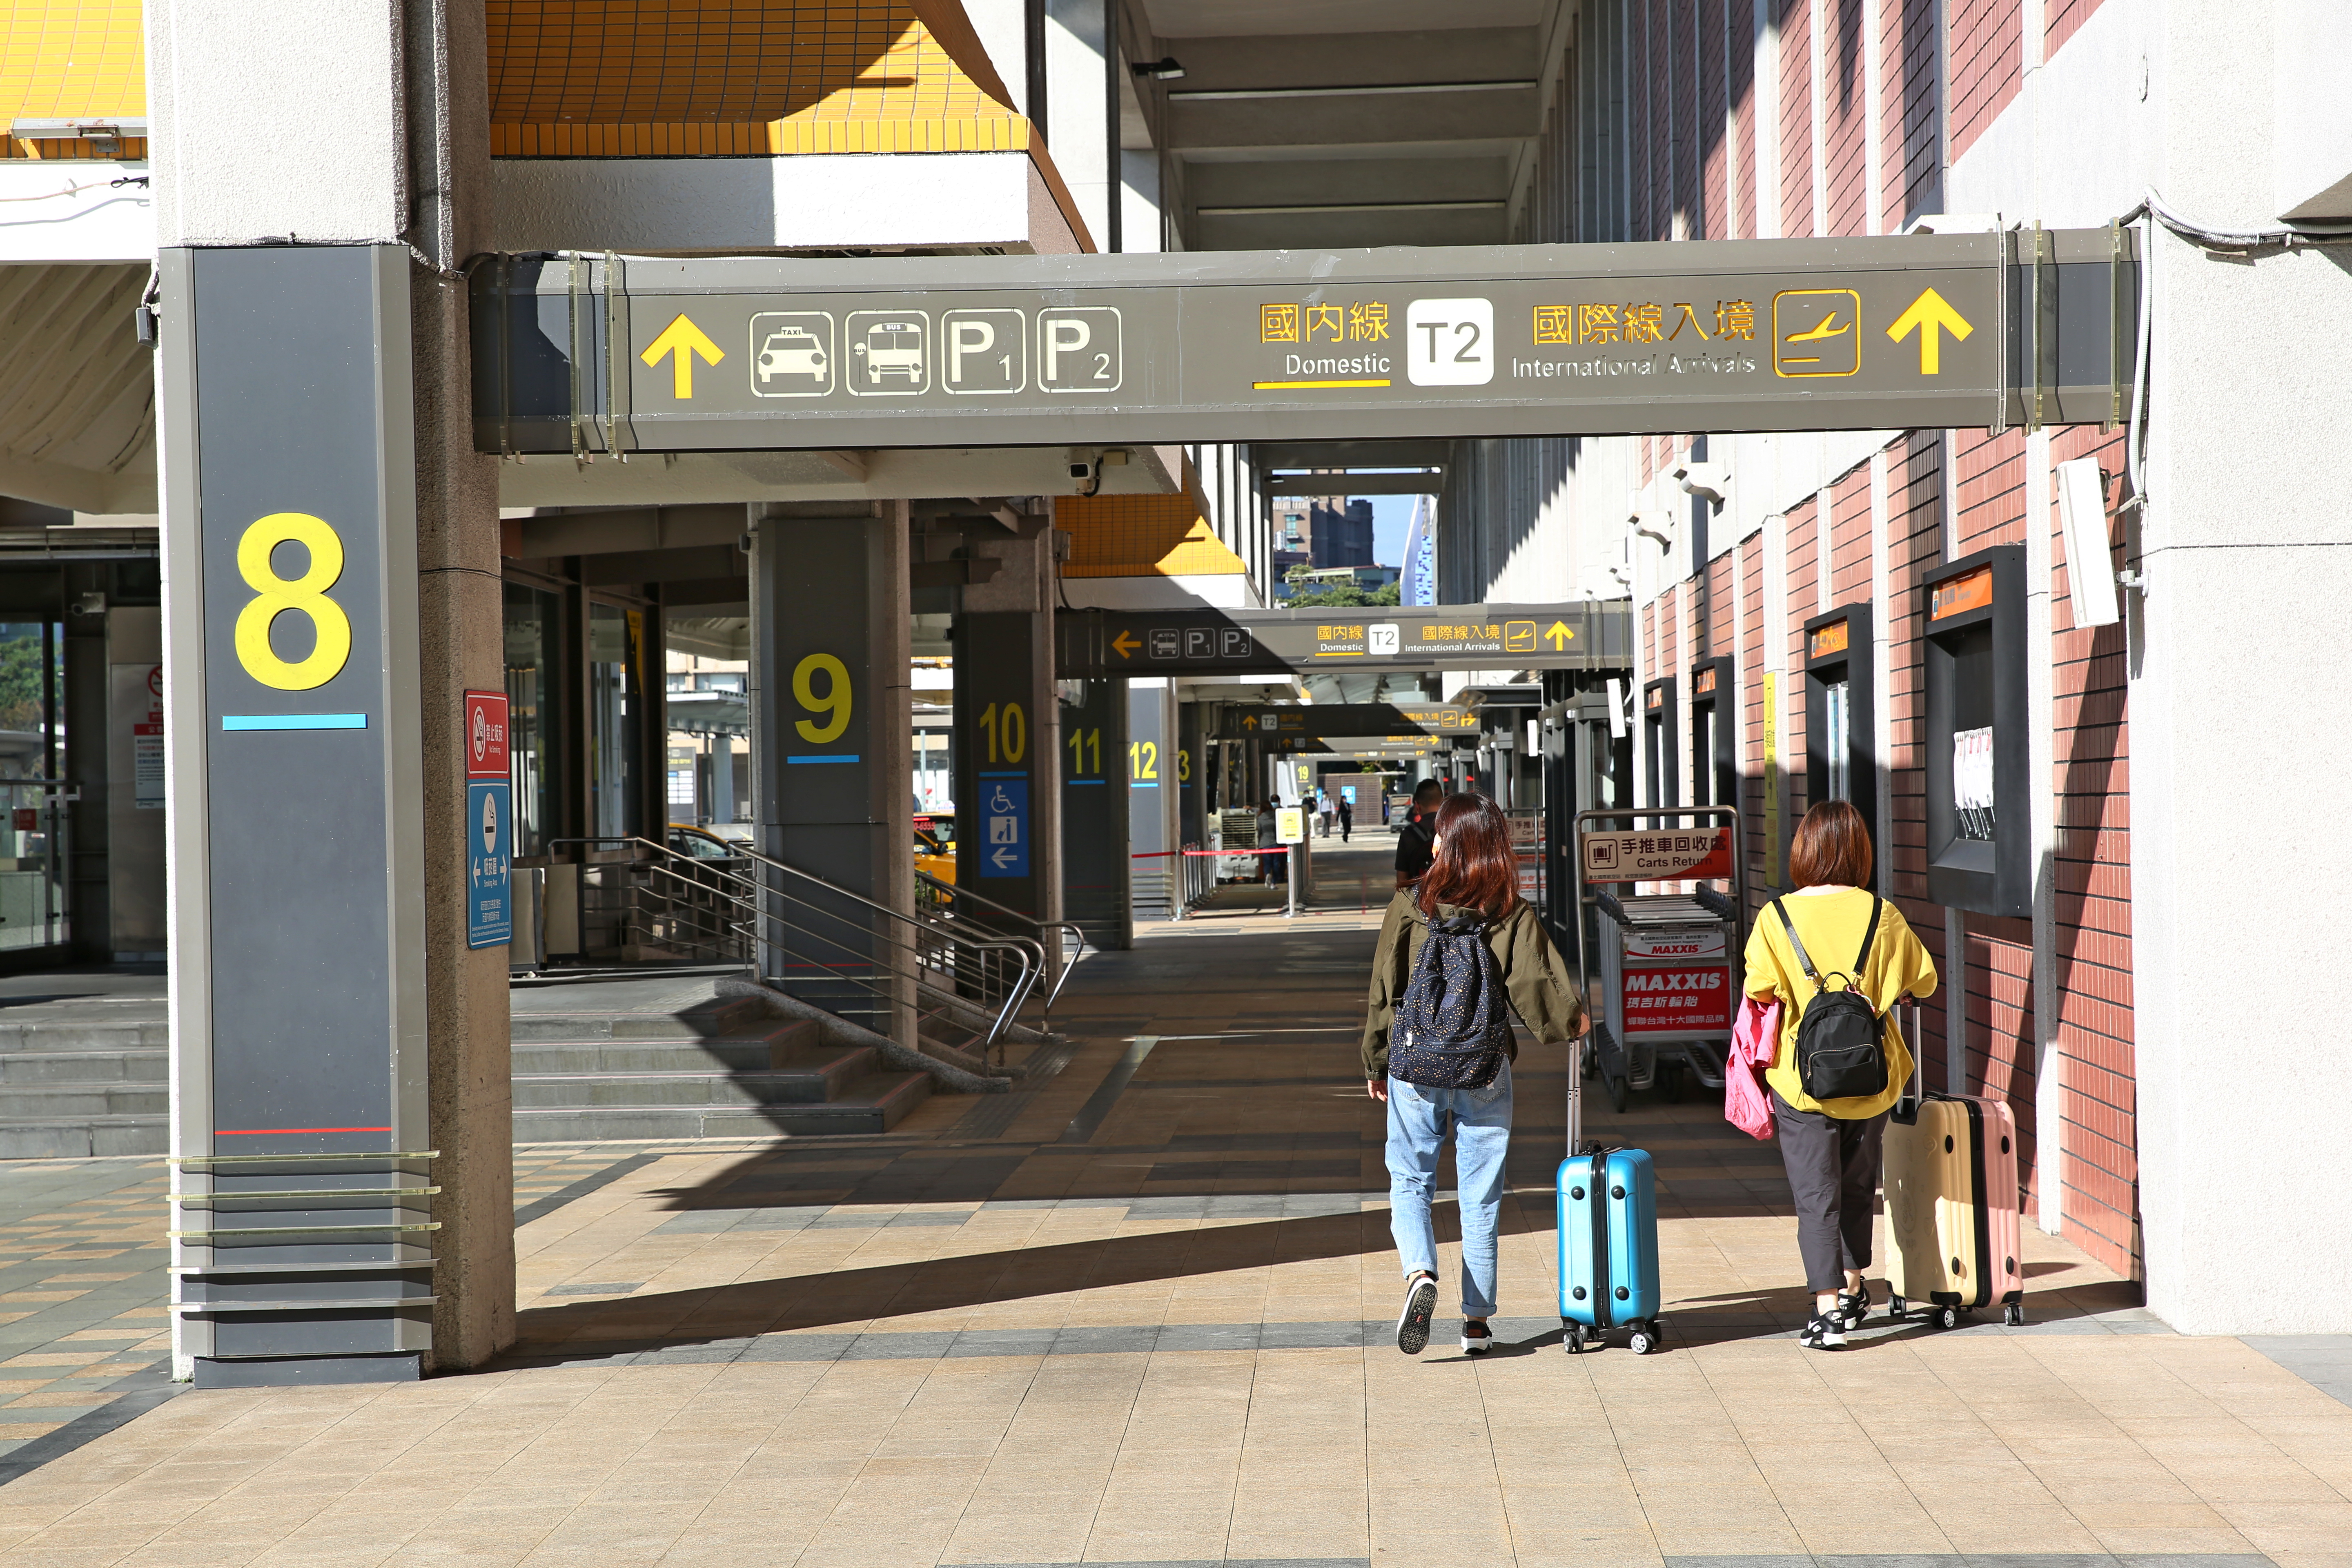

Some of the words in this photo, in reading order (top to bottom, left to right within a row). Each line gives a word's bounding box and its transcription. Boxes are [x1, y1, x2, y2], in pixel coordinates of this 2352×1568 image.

[1260, 301, 1390, 343] 國內線
[1532, 299, 1755, 346] 國際線入境
[1417, 322, 1481, 363] T2
[1286, 352, 1390, 375] Domestic
[1512, 354, 1657, 378] International
[1664, 352, 1755, 374] Arrivals
[235, 512, 352, 691] 8
[1317, 625, 1363, 640] 國內線
[1372, 631, 1395, 646] T2
[1422, 624, 1500, 641] 國際線入境
[1320, 643, 1363, 651] Domestic
[1405, 644, 1462, 652] International
[1464, 642, 1500, 651] Arrivals
[793, 653, 852, 744] 9
[1263, 717, 1275, 726] T2
[980, 702, 1025, 763] 10
[1069, 728, 1100, 774] 11
[1130, 742, 1157, 779] 12
[1178, 750, 1190, 781] 3
[1298, 765, 1309, 780] 19
[1621, 835, 1726, 854] 手推車回收處
[1637, 858, 1668, 867] Carts
[1673, 857, 1712, 866] Return
[1651, 944, 1699, 954] MAXXIS
[1625, 973, 1720, 991] MAXXIS
[1626, 996, 1698, 1008] 瑪吉斯輪胎
